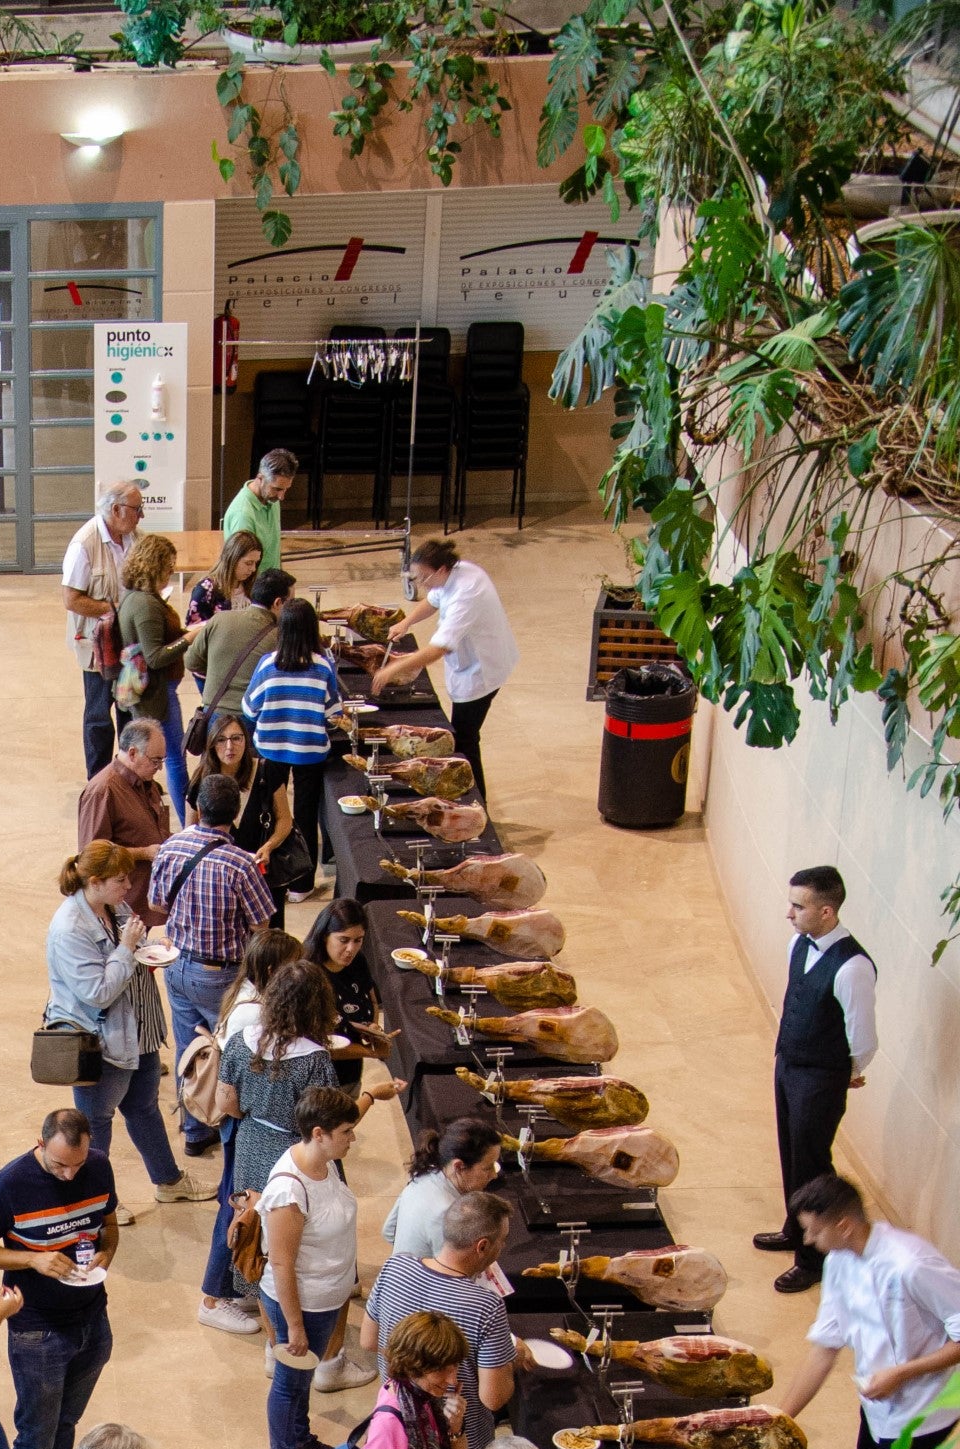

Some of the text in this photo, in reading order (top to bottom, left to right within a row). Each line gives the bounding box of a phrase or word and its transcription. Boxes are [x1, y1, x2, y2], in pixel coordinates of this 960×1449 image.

[462, 266, 562, 276] Palacio
[228, 274, 329, 284] Palacio
[228, 289, 240, 297] DE
[246, 287, 323, 297] EXPOSICIONES
[340, 284, 402, 294] CONGRESOS
[461, 288, 601, 301] Terue
[228, 293, 397, 309] Teruel
[107, 329, 151, 346] punto
[141, 496, 166, 504] CIAS!
[47, 1217, 91, 1235] JACK&JONES
